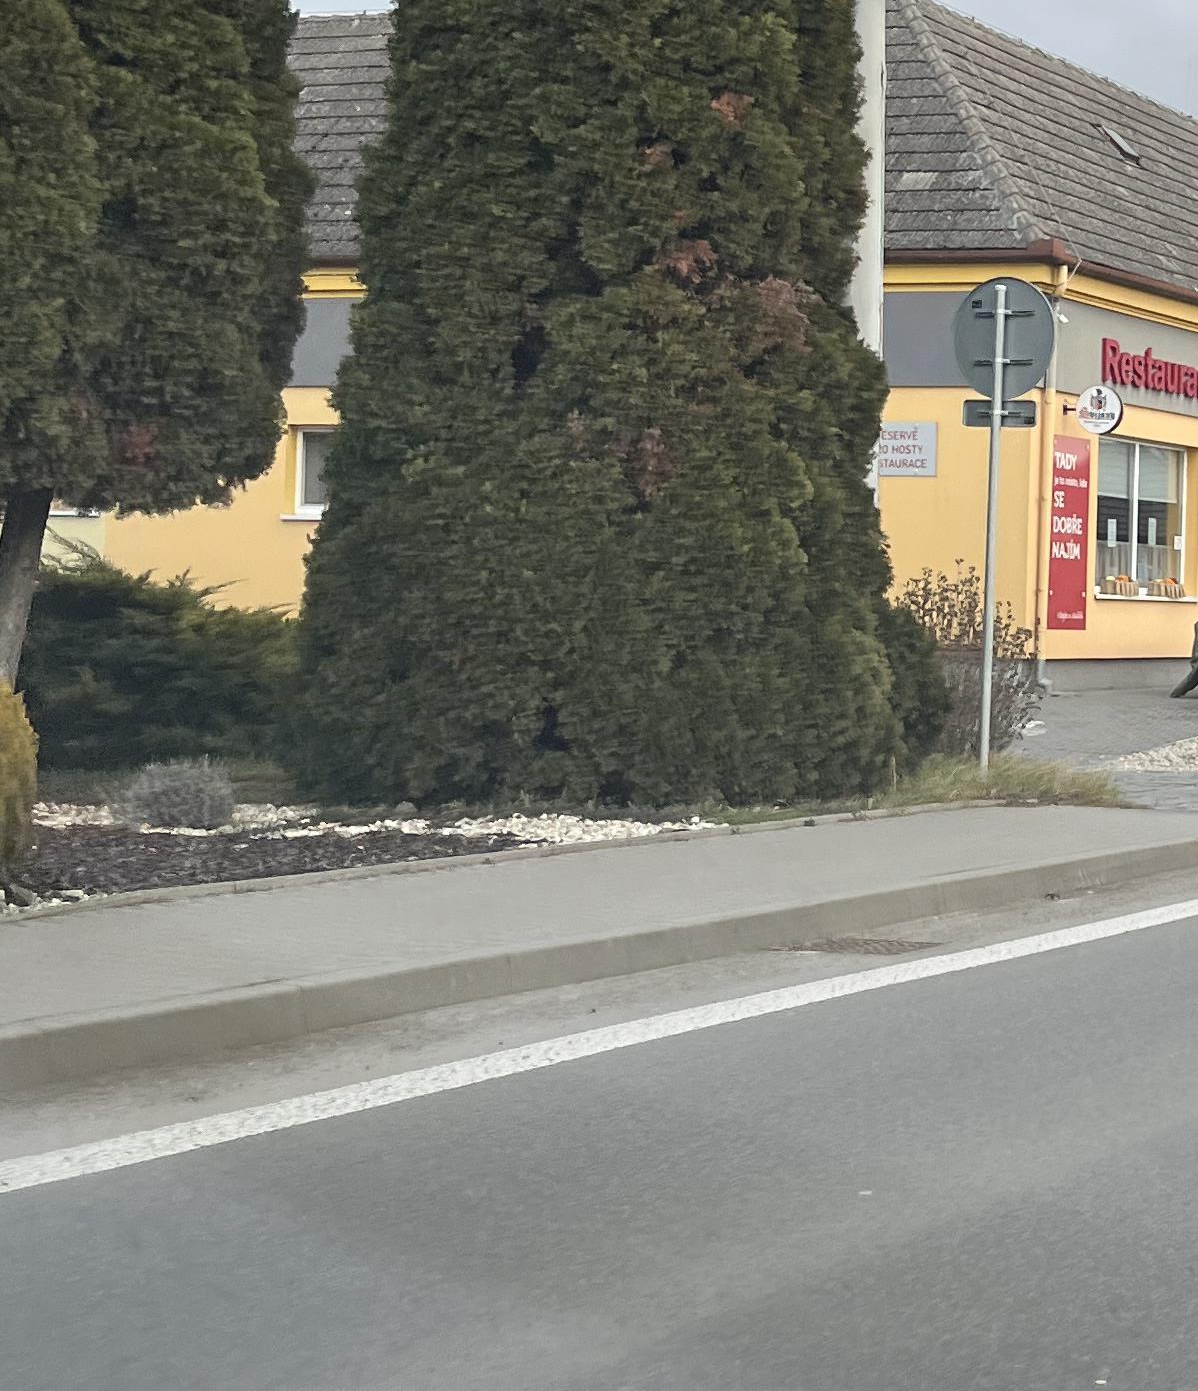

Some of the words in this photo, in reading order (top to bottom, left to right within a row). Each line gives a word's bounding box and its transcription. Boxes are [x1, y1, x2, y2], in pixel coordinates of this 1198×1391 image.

[891, 444, 924, 455] HOSTY
[880, 458, 928, 469] STAURACE
[1055, 451, 1078, 471] TADY
[1053, 490, 1065, 508] SE
[1052, 513, 1083, 536] DOBŘE
[1051, 539, 1081, 560] NAJÍM
